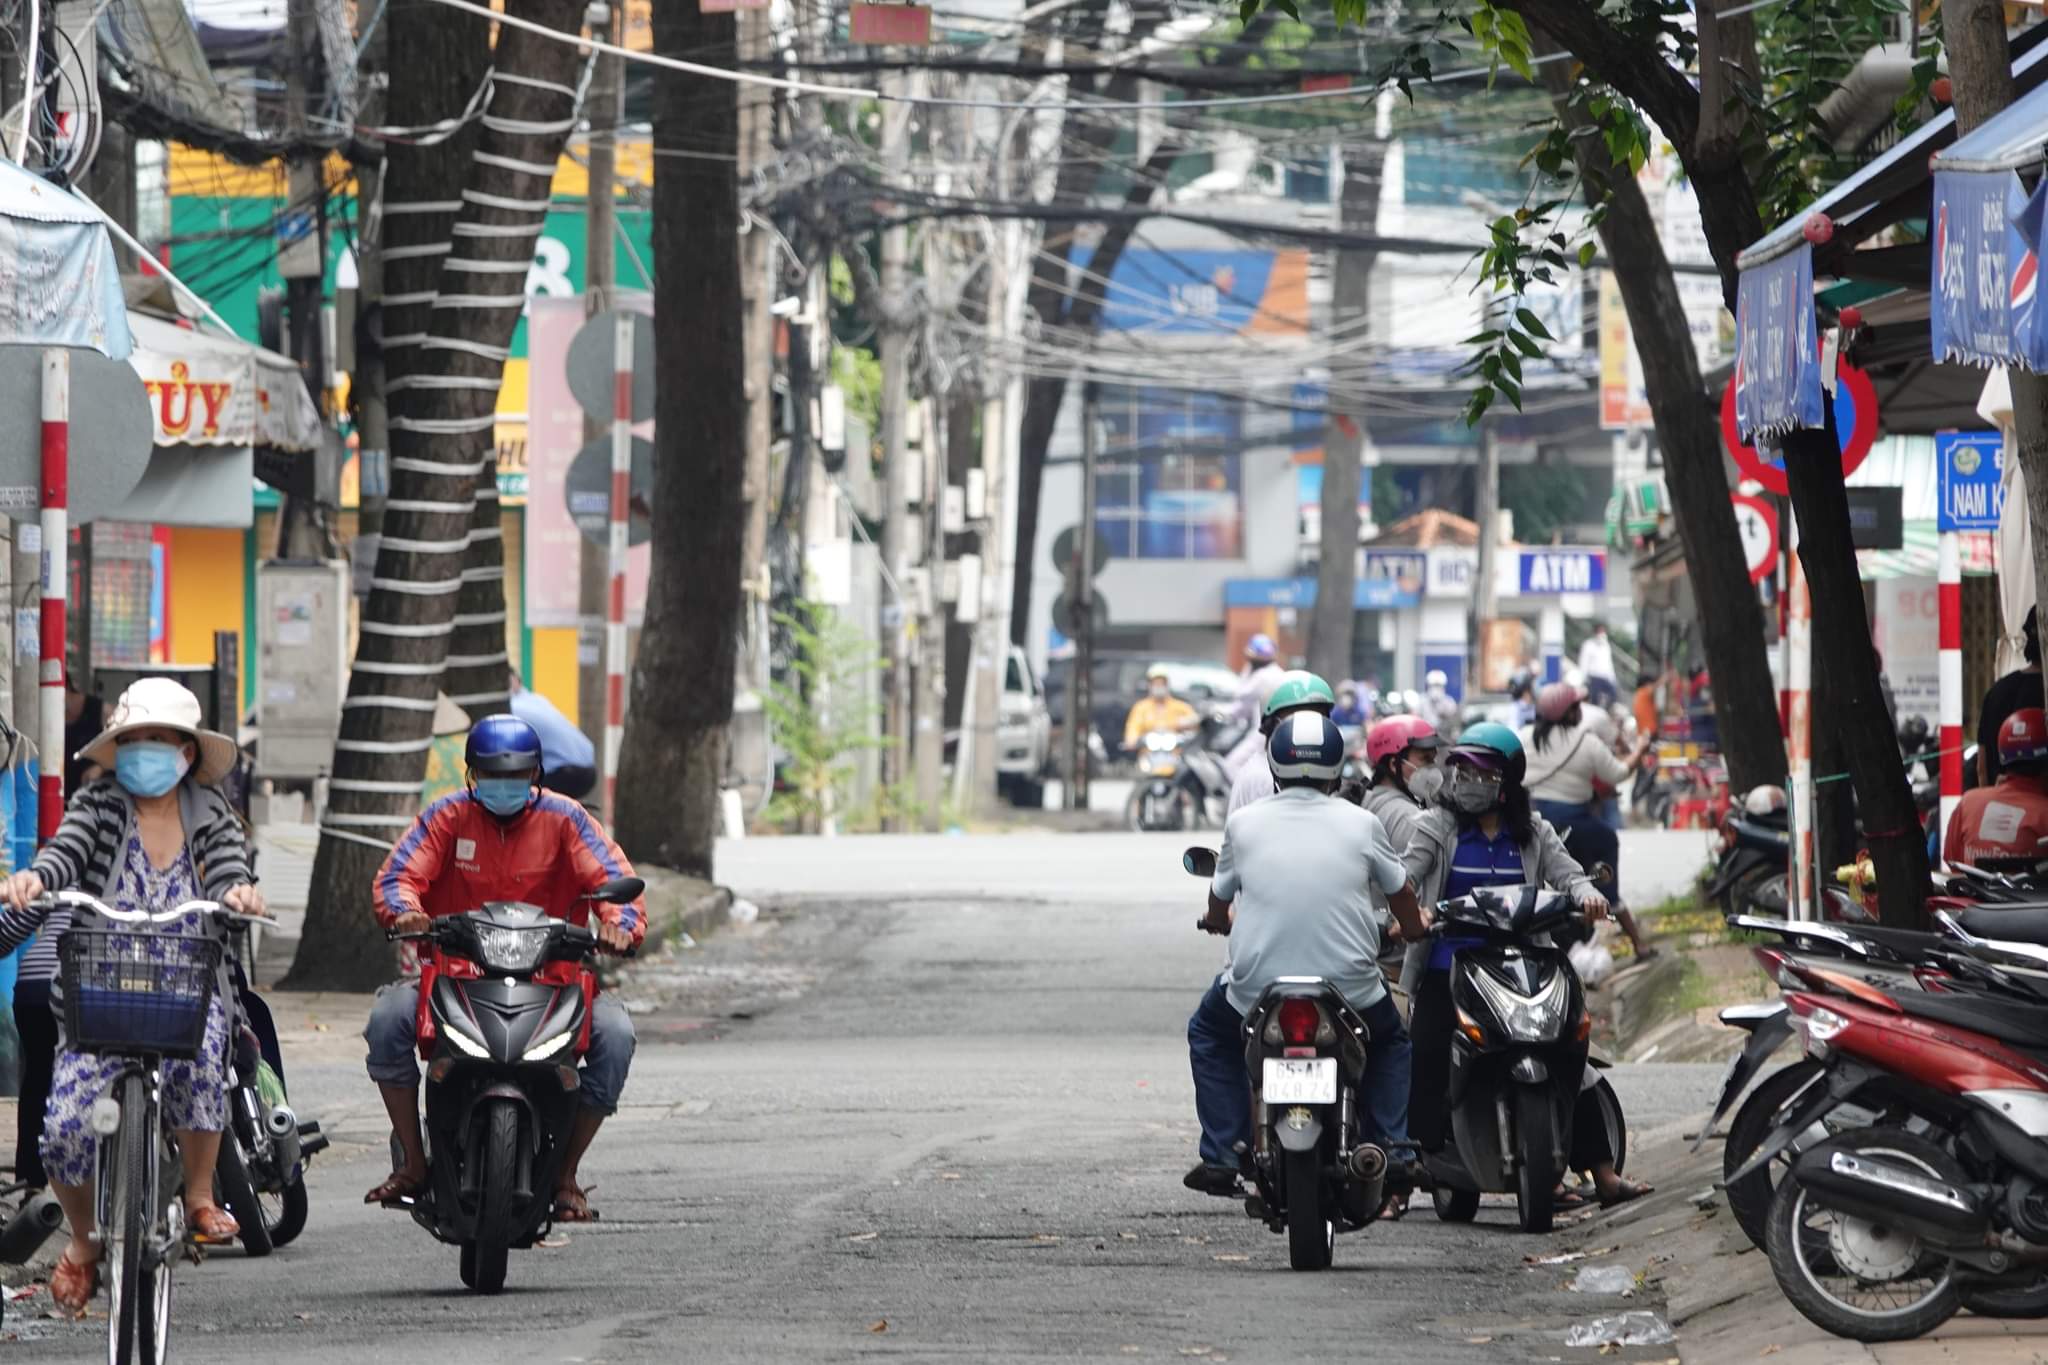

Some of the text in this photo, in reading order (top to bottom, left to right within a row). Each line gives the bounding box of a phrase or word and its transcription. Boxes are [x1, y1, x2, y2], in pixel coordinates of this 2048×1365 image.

[144, 361, 231, 437] ỦY
[1953, 484, 1986, 517] NAM
[1530, 555, 1590, 591] ATM
